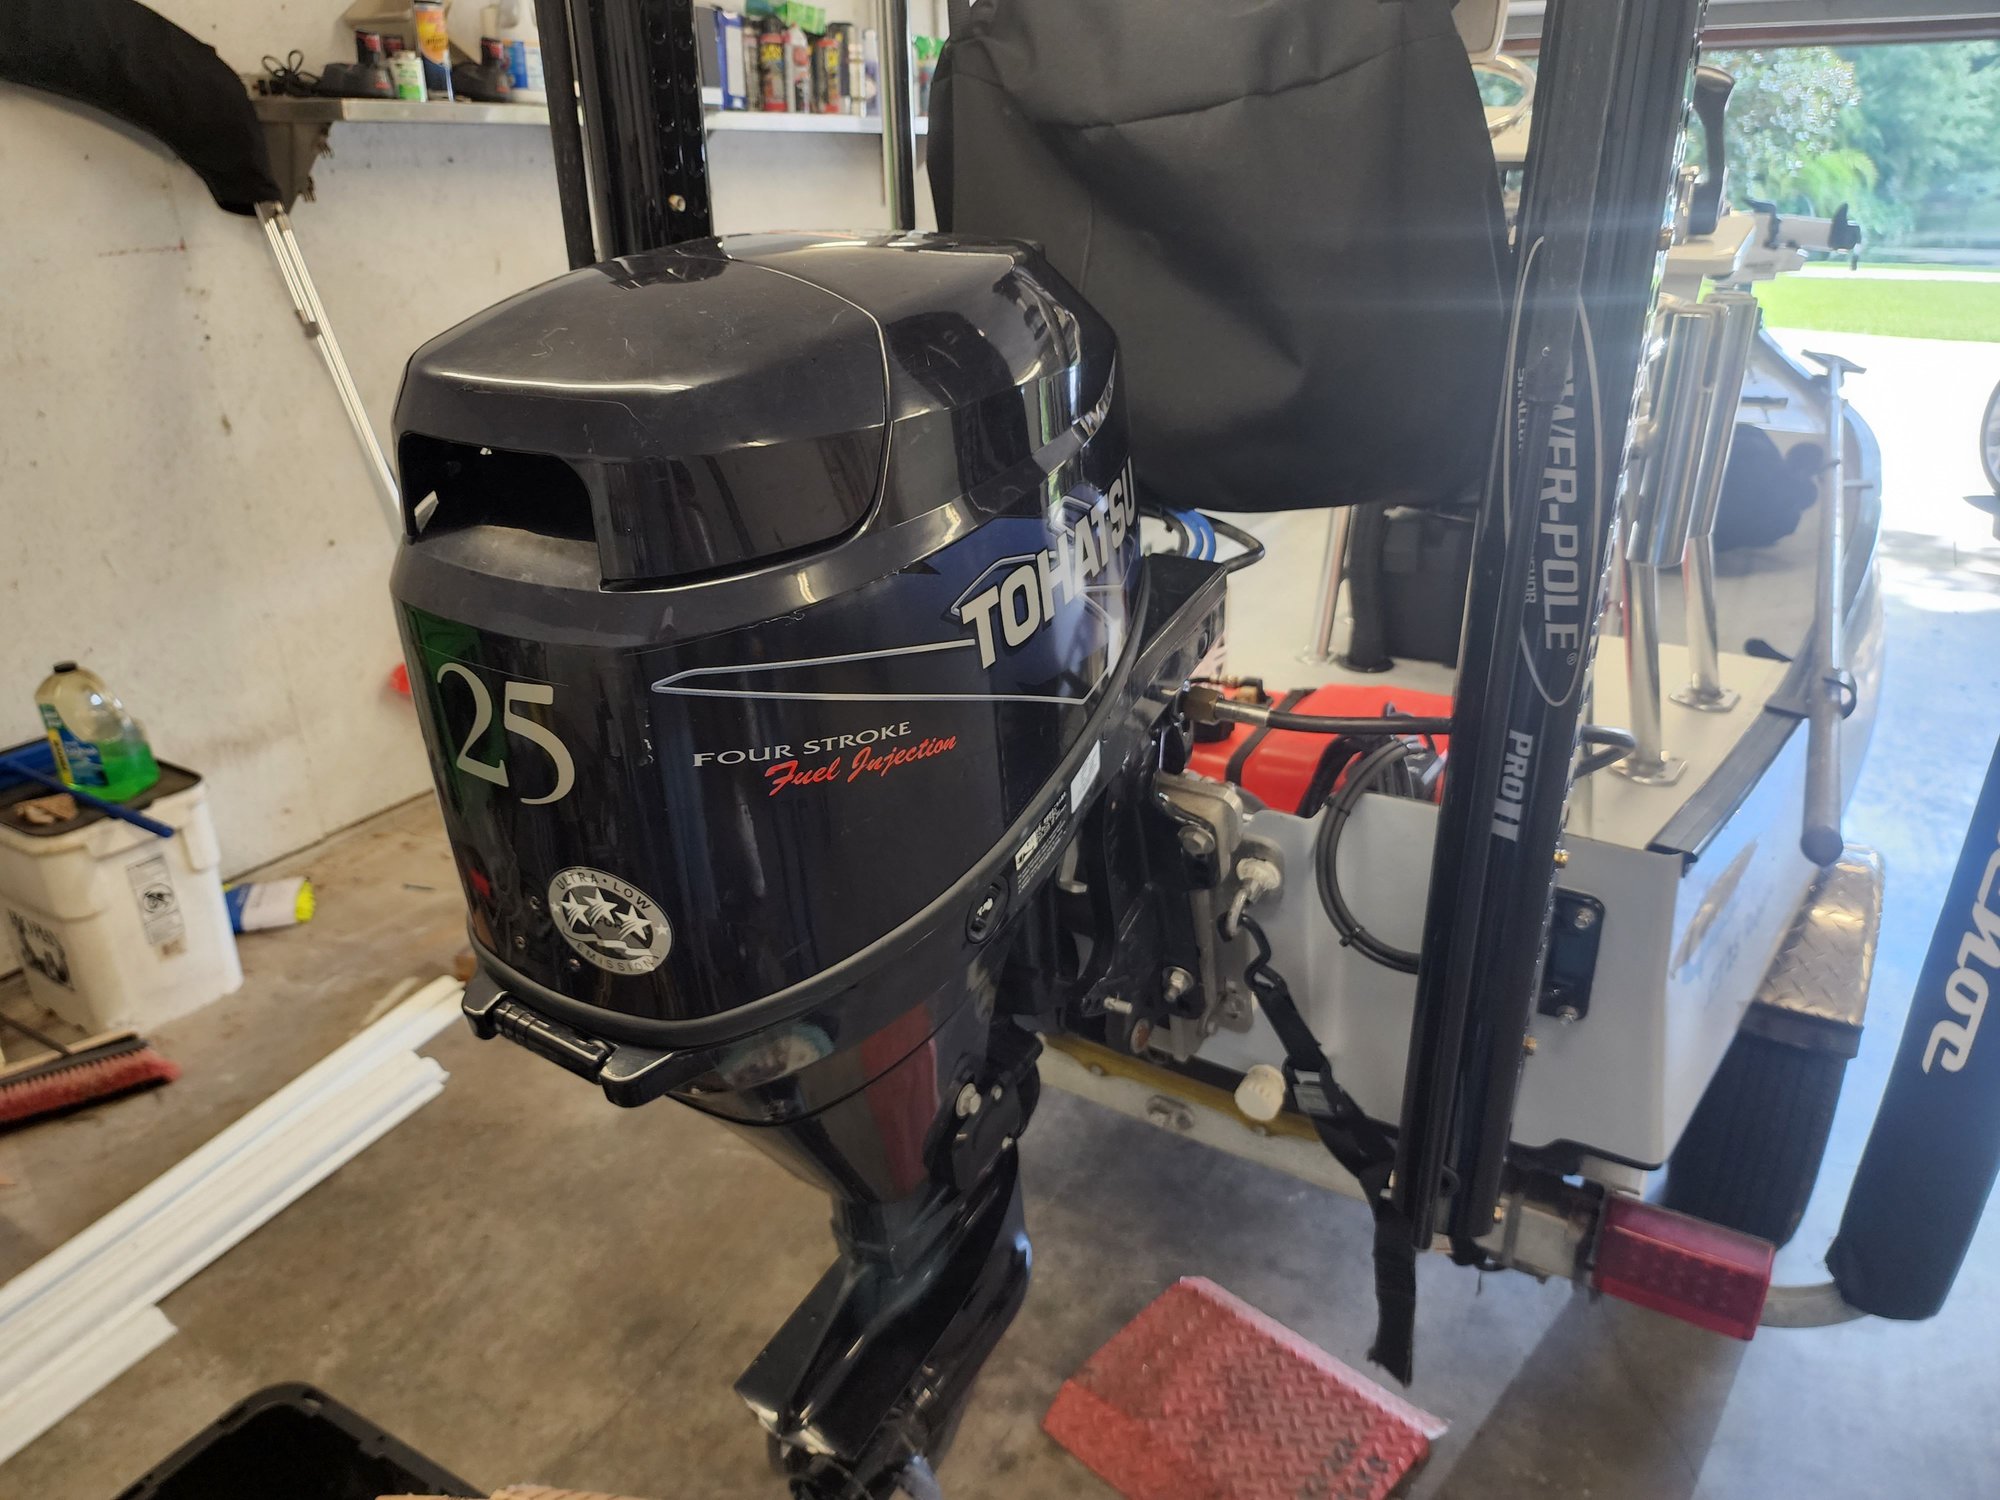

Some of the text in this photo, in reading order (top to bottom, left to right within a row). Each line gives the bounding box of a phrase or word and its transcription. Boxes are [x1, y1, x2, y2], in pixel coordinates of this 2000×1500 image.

[960, 455, 1137, 670] TOHATSU
[437, 663, 575, 805] 25
[693, 721, 912, 767] FOUR STROKE
[764, 735, 957, 797] Fuel Injection
[556, 872, 652, 910] ULTRA LOW
[577, 943, 655, 971] EMISSION
